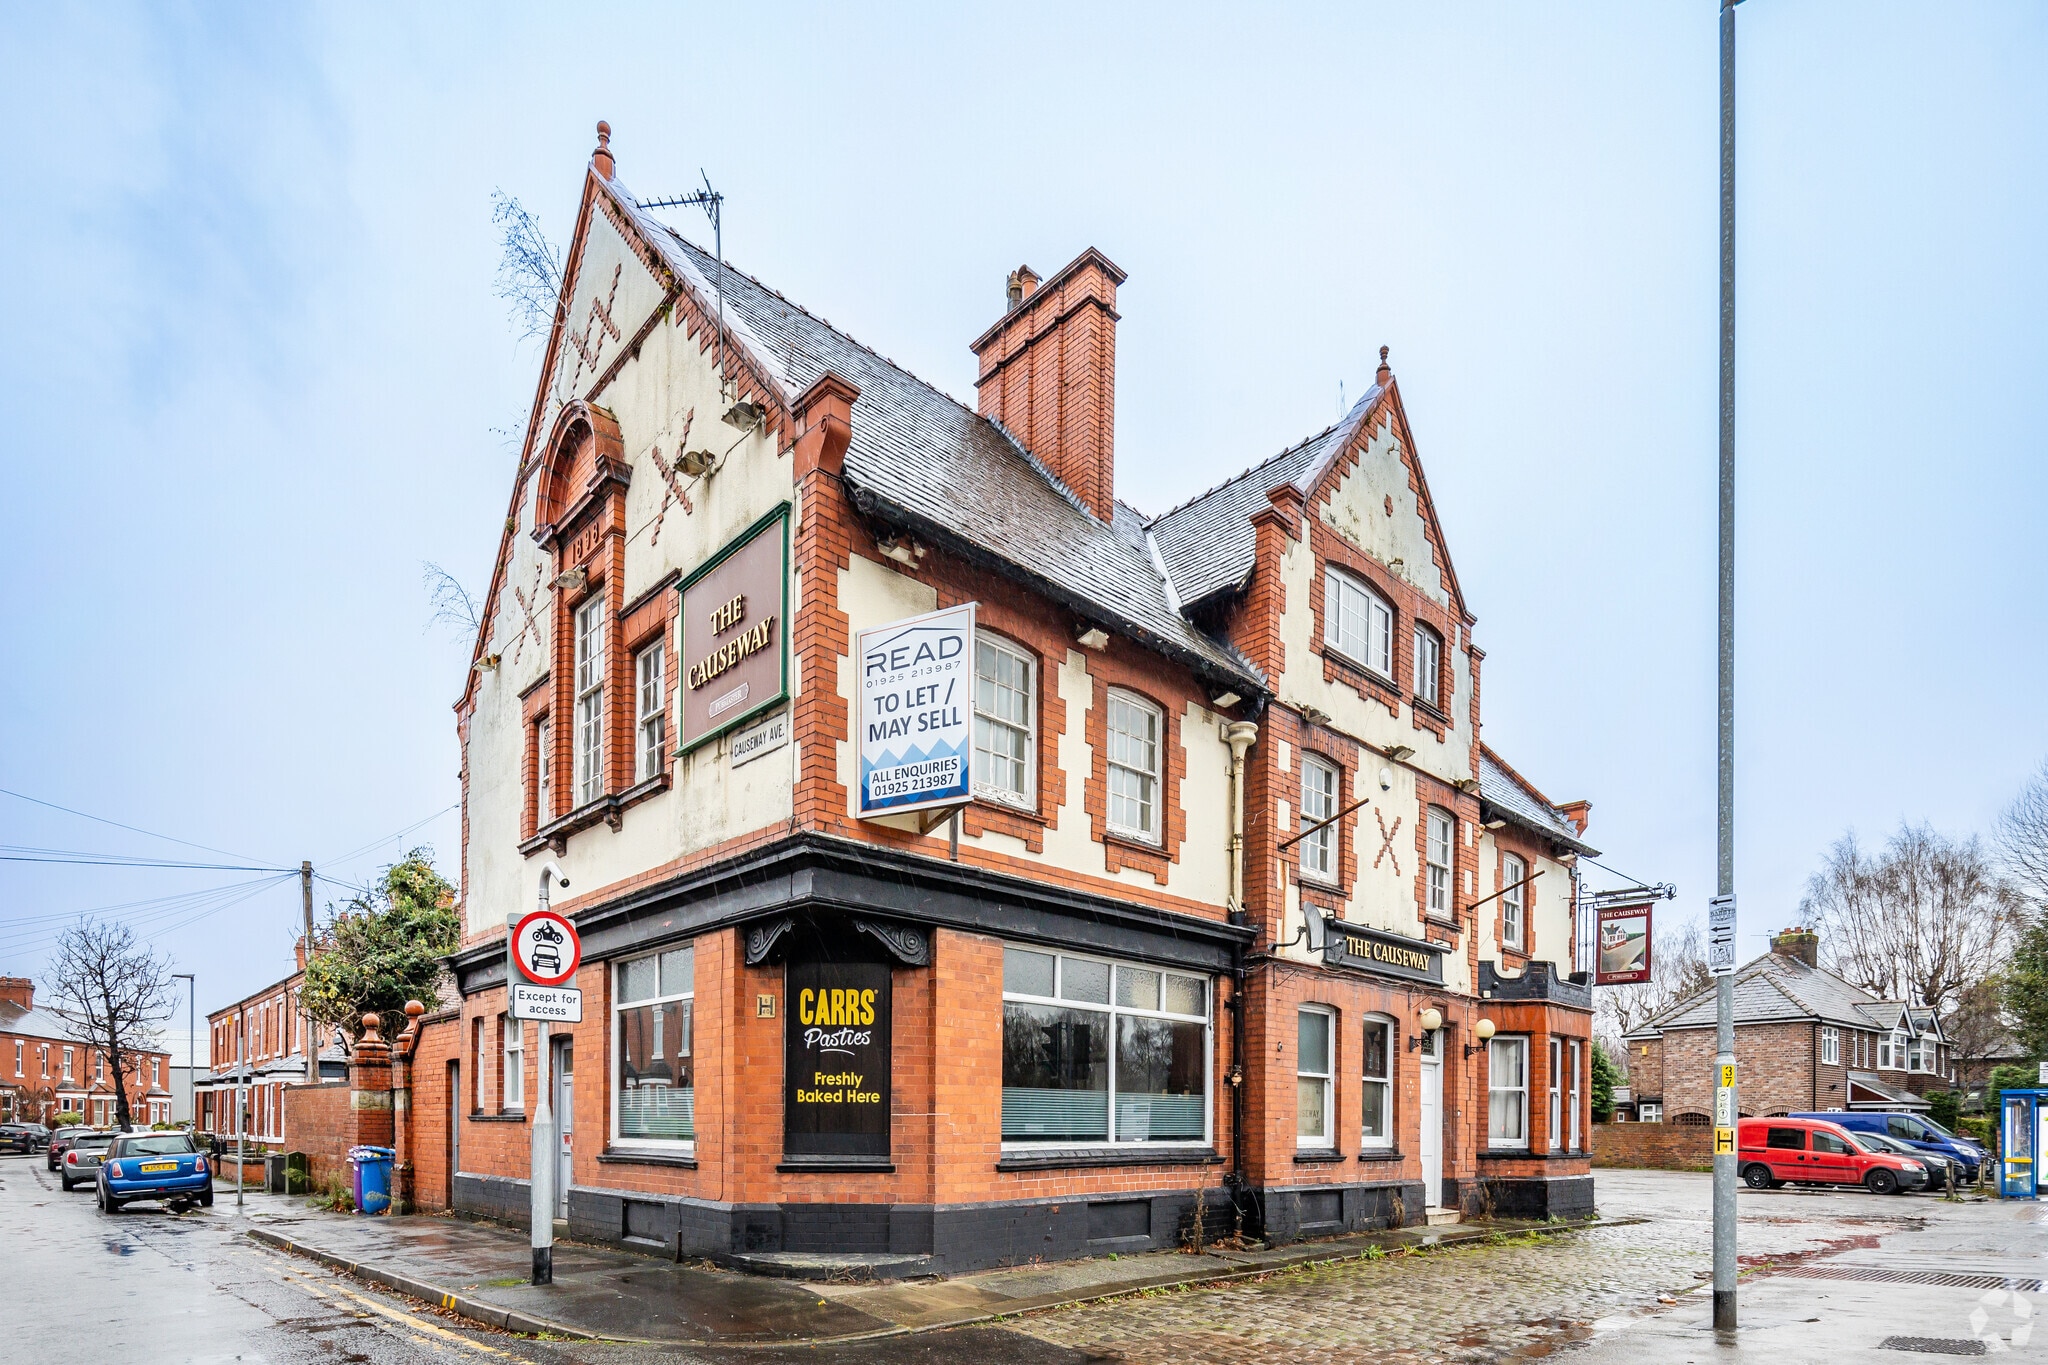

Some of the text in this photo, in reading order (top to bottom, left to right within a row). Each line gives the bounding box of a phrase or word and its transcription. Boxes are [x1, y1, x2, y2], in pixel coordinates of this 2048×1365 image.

[571, 522, 600, 565] 1898
[709, 594, 744, 637] THE
[687, 616, 774, 691] CAUSEWAY
[866, 635, 963, 677] READ
[866, 660, 961, 689] 01925 213987
[873, 677, 956, 716] TO LET /
[869, 706, 962, 742] MAY SELL
[733, 723, 785, 758] CAUSEWAY AVE.
[872, 758, 958, 784] ALL ENQUIRIES
[874, 773, 955, 797] 01925 213987
[1613, 908, 1649, 918] CAUSEWAY
[1346, 935, 1430, 971] THE CAUSEWAY
[518, 990, 577, 1004] Except for
[529, 1005, 567, 1016] access
[800, 988, 875, 1025] CARRS
[804, 1027, 871, 1049] Pasties
[814, 1071, 863, 1089] Freshly
[1725, 1066, 1733, 1076] 3
[797, 1089, 881, 1103] Baked Here
[1717, 1130, 1734, 1152] H
